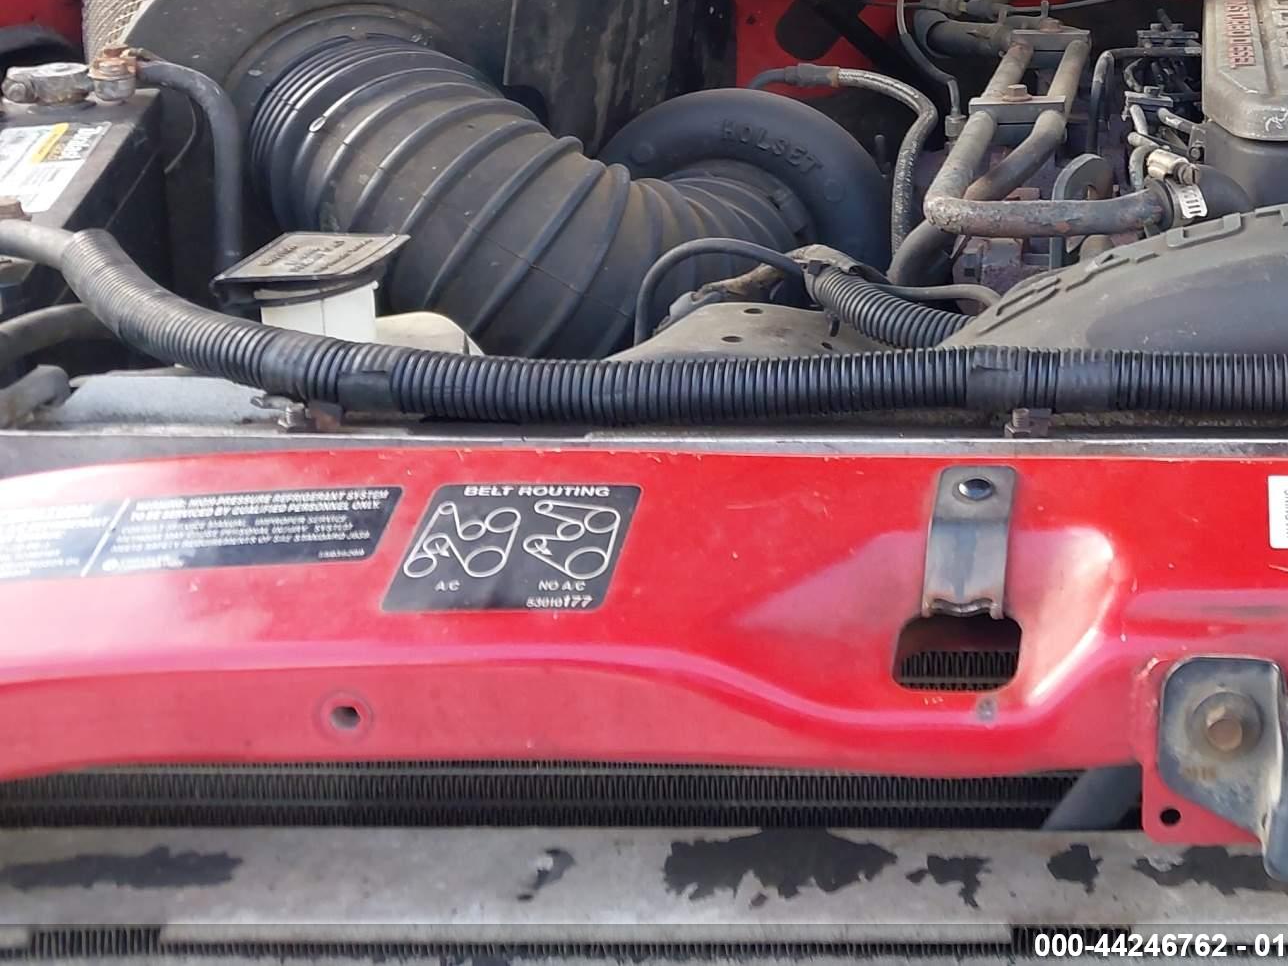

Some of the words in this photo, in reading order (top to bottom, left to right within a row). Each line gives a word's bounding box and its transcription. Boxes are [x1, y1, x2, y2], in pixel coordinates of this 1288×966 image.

[721, 118, 825, 174] HOLSET
[347, 489, 390, 501] SYSTEM
[463, 485, 514, 497] BELT
[518, 486, 610, 498] ROUTING
[215, 505, 233, 517] BY
[288, 501, 350, 514] PERSONNEL
[538, 580, 559, 592] NO
